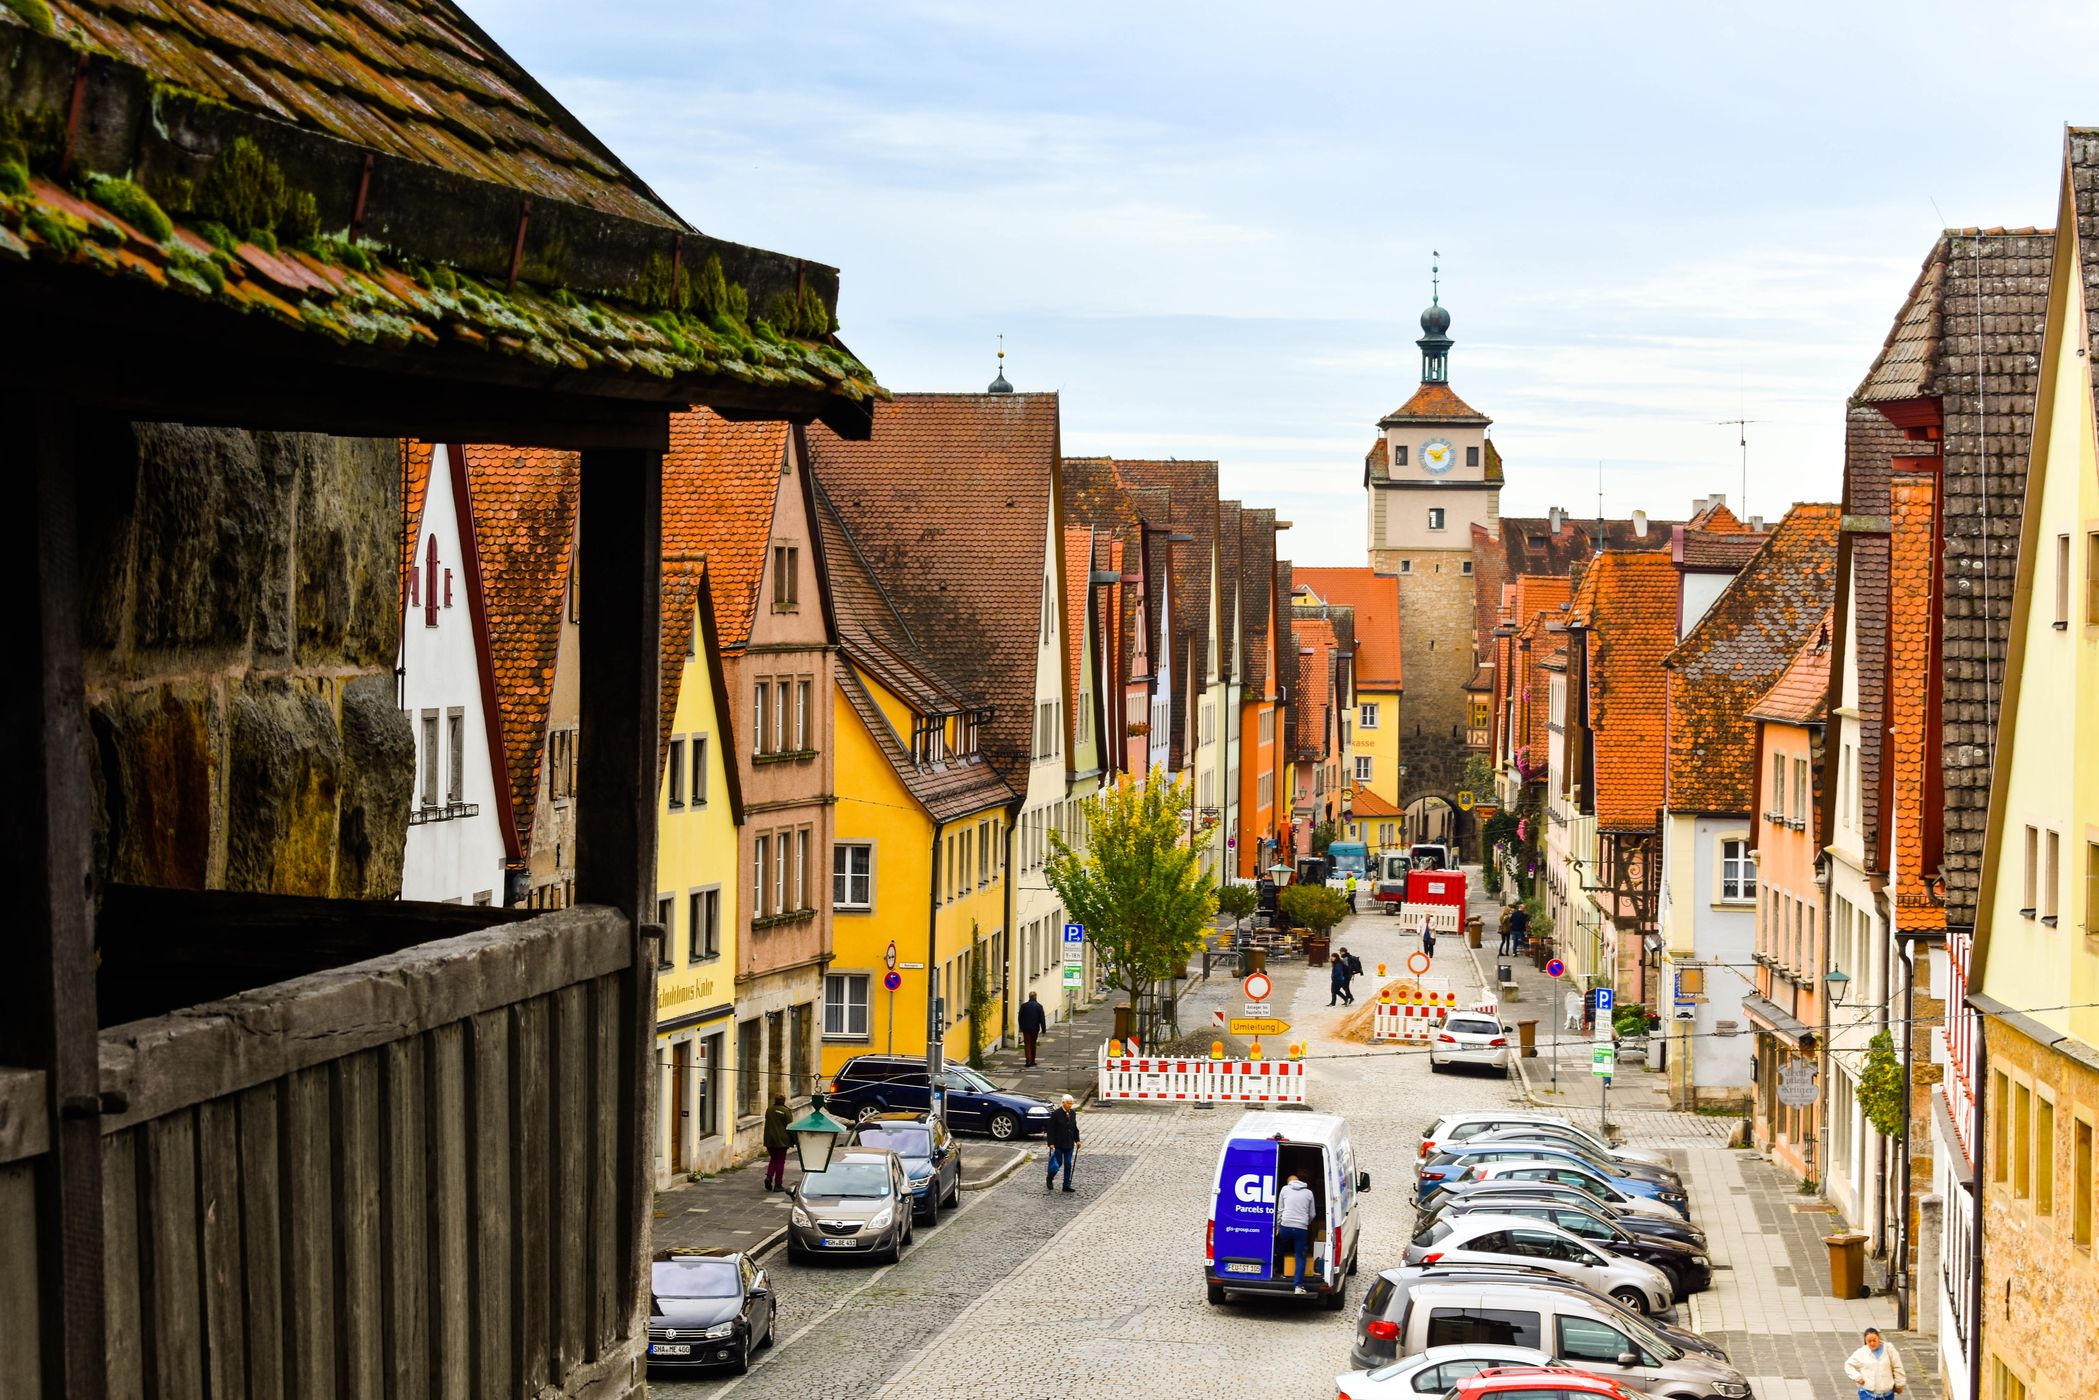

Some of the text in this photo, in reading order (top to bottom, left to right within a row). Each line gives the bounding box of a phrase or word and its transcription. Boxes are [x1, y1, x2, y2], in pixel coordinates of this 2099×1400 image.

[1068, 926, 1079, 941] P
[1599, 990, 1609, 1008] P
[1233, 1023, 1276, 1032] Umleitung
[1235, 1205, 1275, 1214] Parcels to
